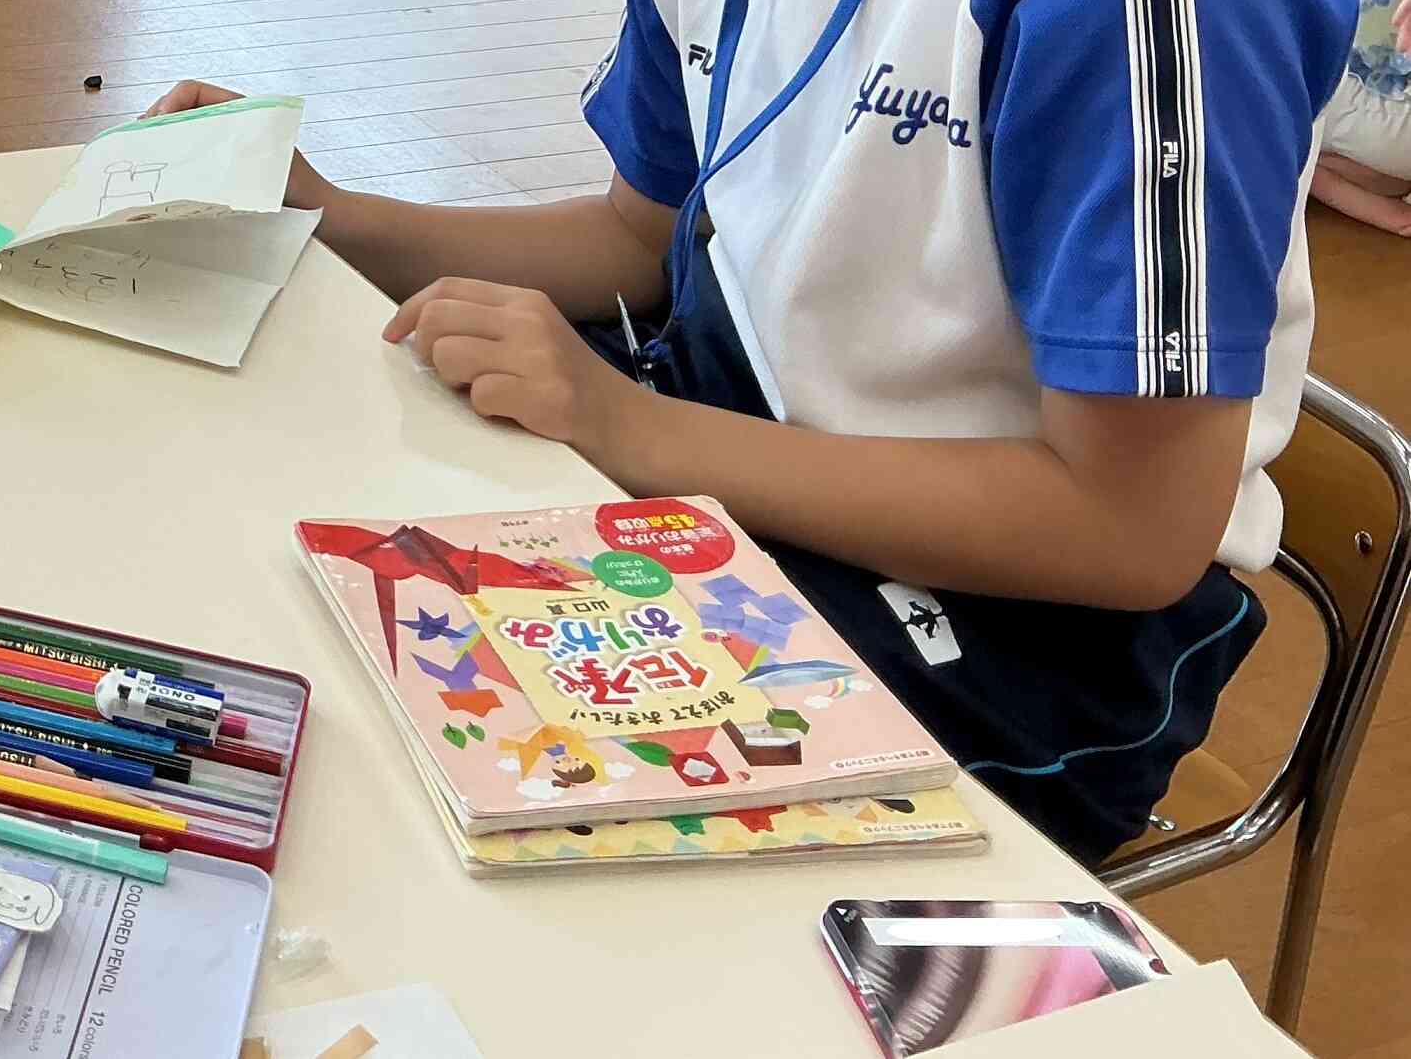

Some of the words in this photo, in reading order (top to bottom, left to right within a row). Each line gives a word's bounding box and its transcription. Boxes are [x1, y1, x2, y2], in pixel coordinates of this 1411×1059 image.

[688, 43, 716, 75] FIL
[1162, 141, 1179, 178] FILA
[1165, 330, 1183, 372] FILA
[574, 600, 610, 612] 山口
[504, 606, 683, 658] おりがみ
[553, 650, 709, 705] 伝承
[570, 709, 664, 726] おきたい!
[673, 691, 735, 721] おぼえて
[113, 883, 144, 948] COLORED
[97, 948, 125, 995] PENCIL
[87, 1010, 106, 1027] 12
